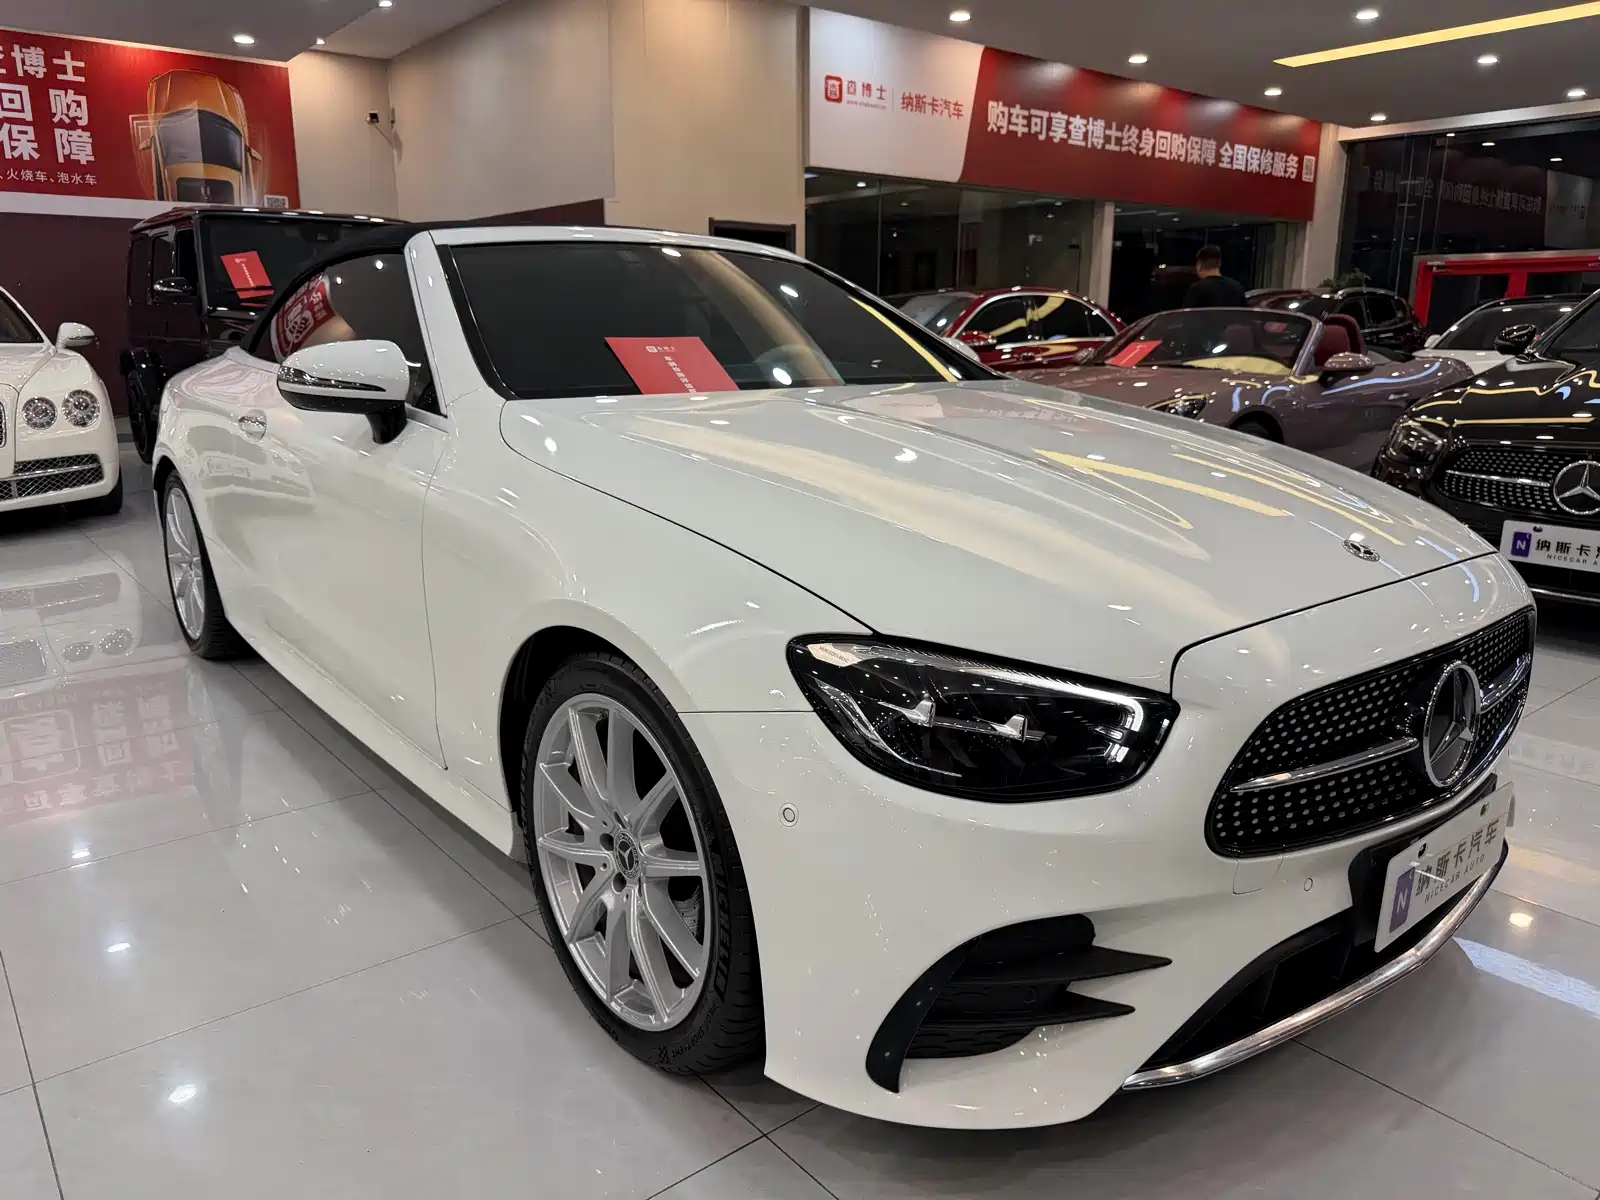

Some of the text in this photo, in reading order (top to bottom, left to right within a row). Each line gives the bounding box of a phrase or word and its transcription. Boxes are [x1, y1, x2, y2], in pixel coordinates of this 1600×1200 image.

[0, 43, 86, 83] 博士
[900, 91, 965, 120] 纳斯卡汽车
[986, 100, 1299, 180] 购车可享查博士终身回购保障 全国保修服务
[1515, 539, 1527, 551] N
[1535, 538, 1600, 559] 纳斯卡
[1546, 553, 1588, 565] NICECAR
[1414, 819, 1500, 897] 纳斯卡汽车
[1423, 853, 1486, 905] NICECAR AUTO
[1395, 887, 1410, 914] N
[711, 850, 732, 997] MICHELIN
